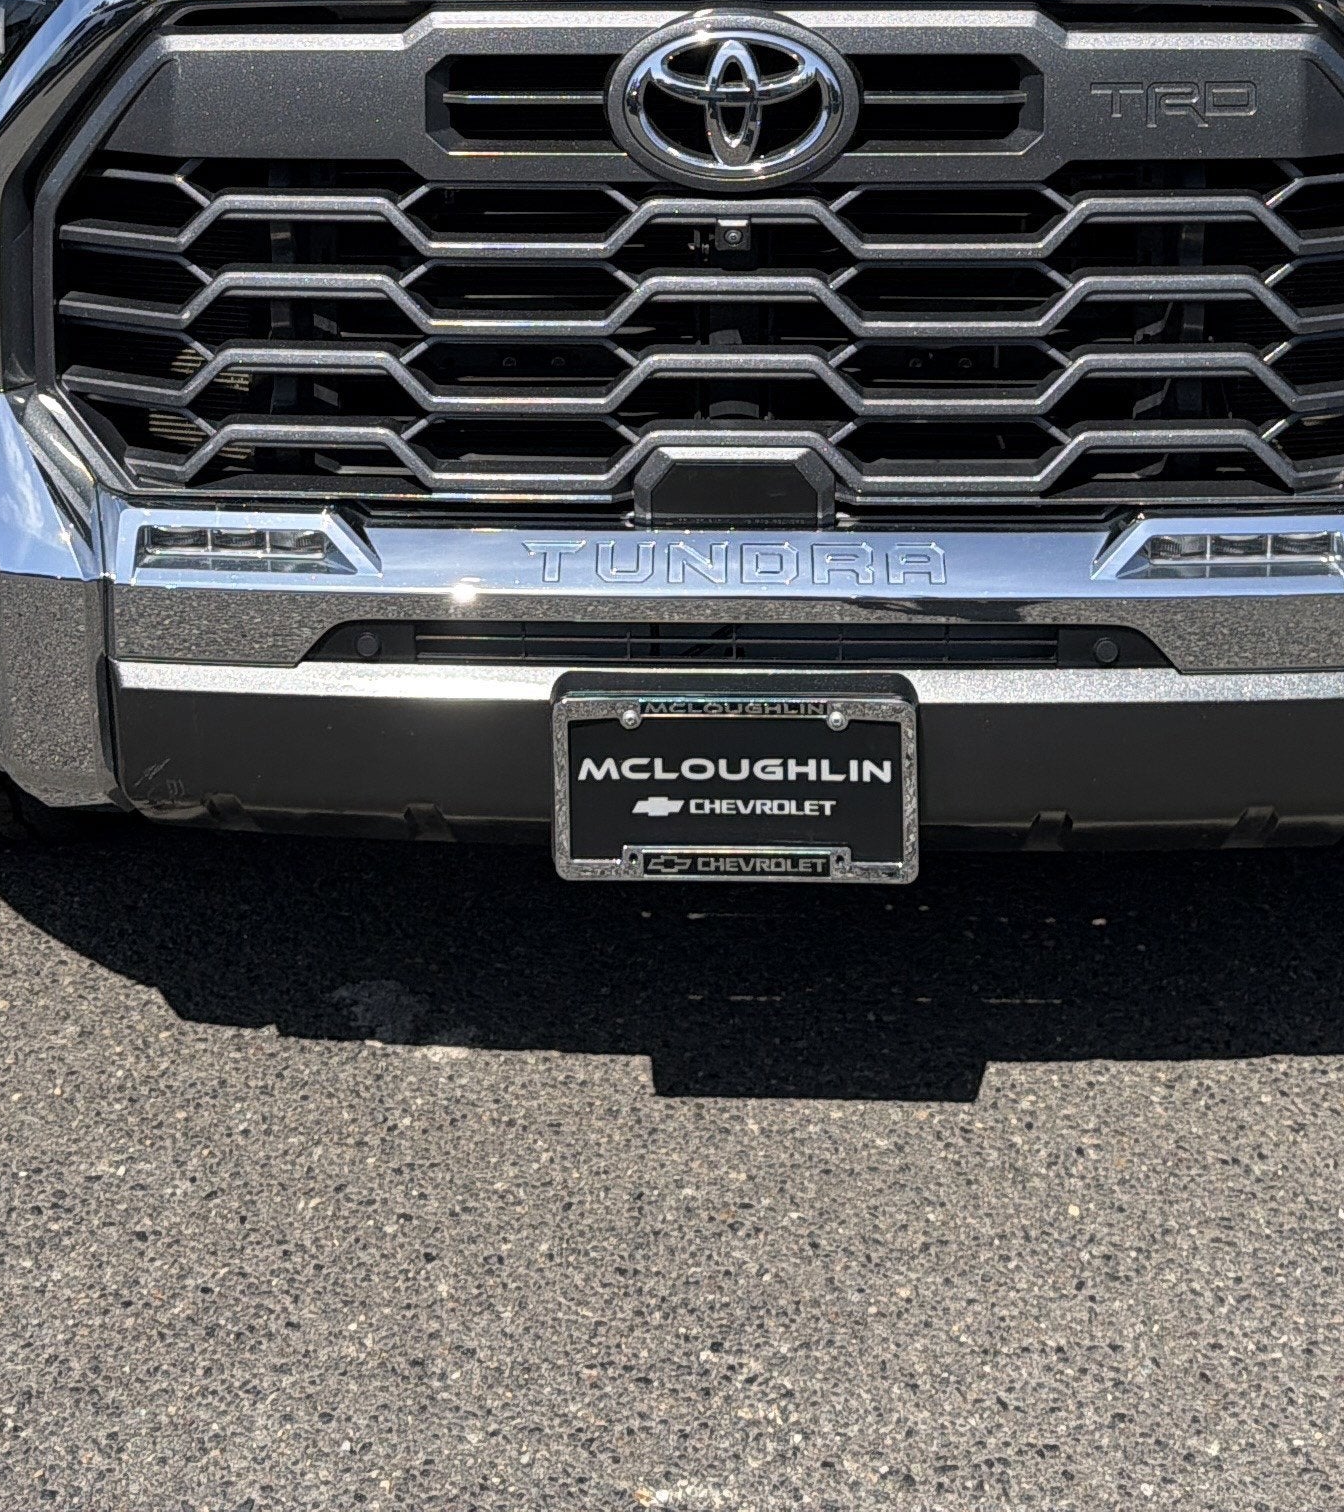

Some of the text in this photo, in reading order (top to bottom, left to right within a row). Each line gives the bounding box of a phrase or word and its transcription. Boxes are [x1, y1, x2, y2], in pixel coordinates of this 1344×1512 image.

[1090, 81, 1257, 128] TRD
[522, 541, 946, 584] TUNDRA
[644, 701, 826, 715] MCLOUGHLIN
[577, 756, 893, 784] MCLOUGHLIN
[689, 798, 837, 816] CHEVROLET
[697, 856, 828, 874] CHEVROLET
